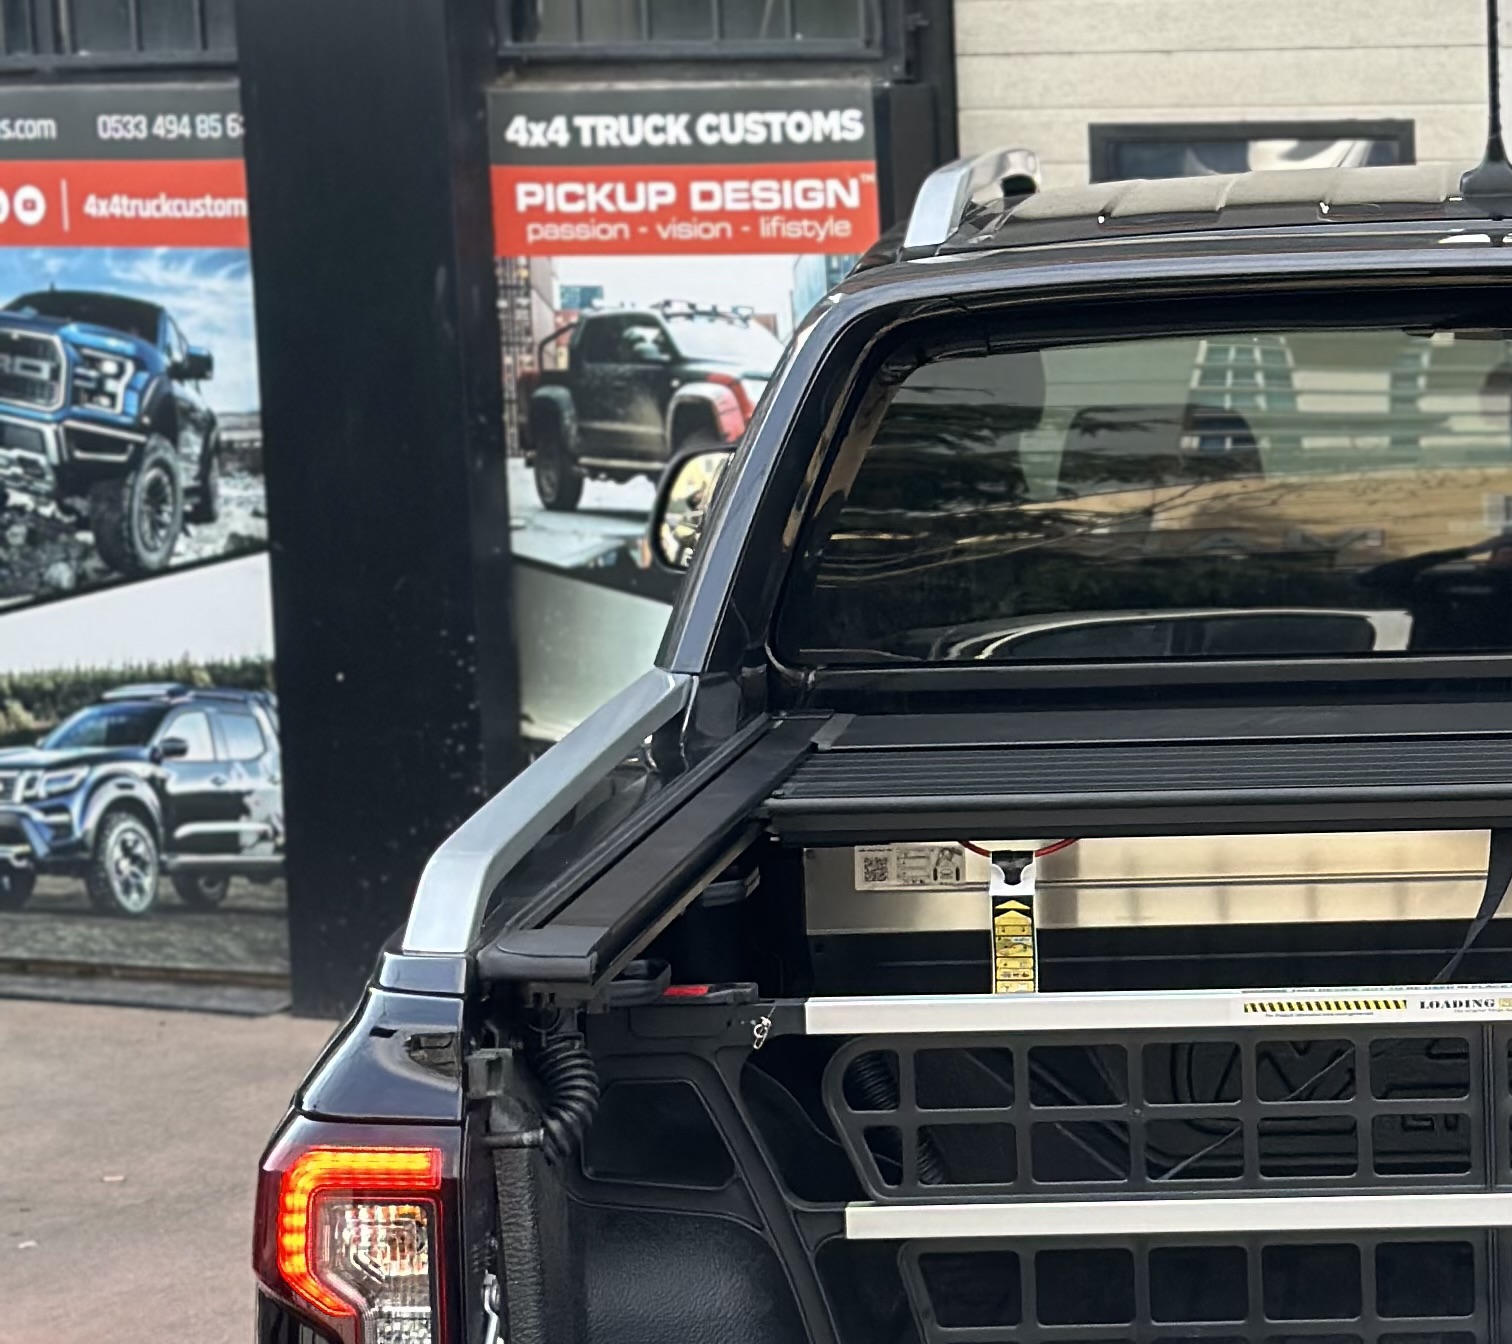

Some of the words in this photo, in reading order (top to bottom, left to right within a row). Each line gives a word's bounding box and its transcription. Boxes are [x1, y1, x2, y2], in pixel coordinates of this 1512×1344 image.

[97, 114, 147, 139] 0533
[152, 113, 192, 138] 494
[195, 113, 222, 138] 85
[505, 115, 570, 147] 4x4
[573, 113, 692, 147] TRUCK
[696, 109, 864, 144] CUSTOMS
[515, 181, 676, 213] PICKUP
[689, 177, 860, 211] DESIGN
[526, 218, 630, 244] passion
[656, 217, 732, 241] vision
[1419, 998, 1496, 1010] LOADING
